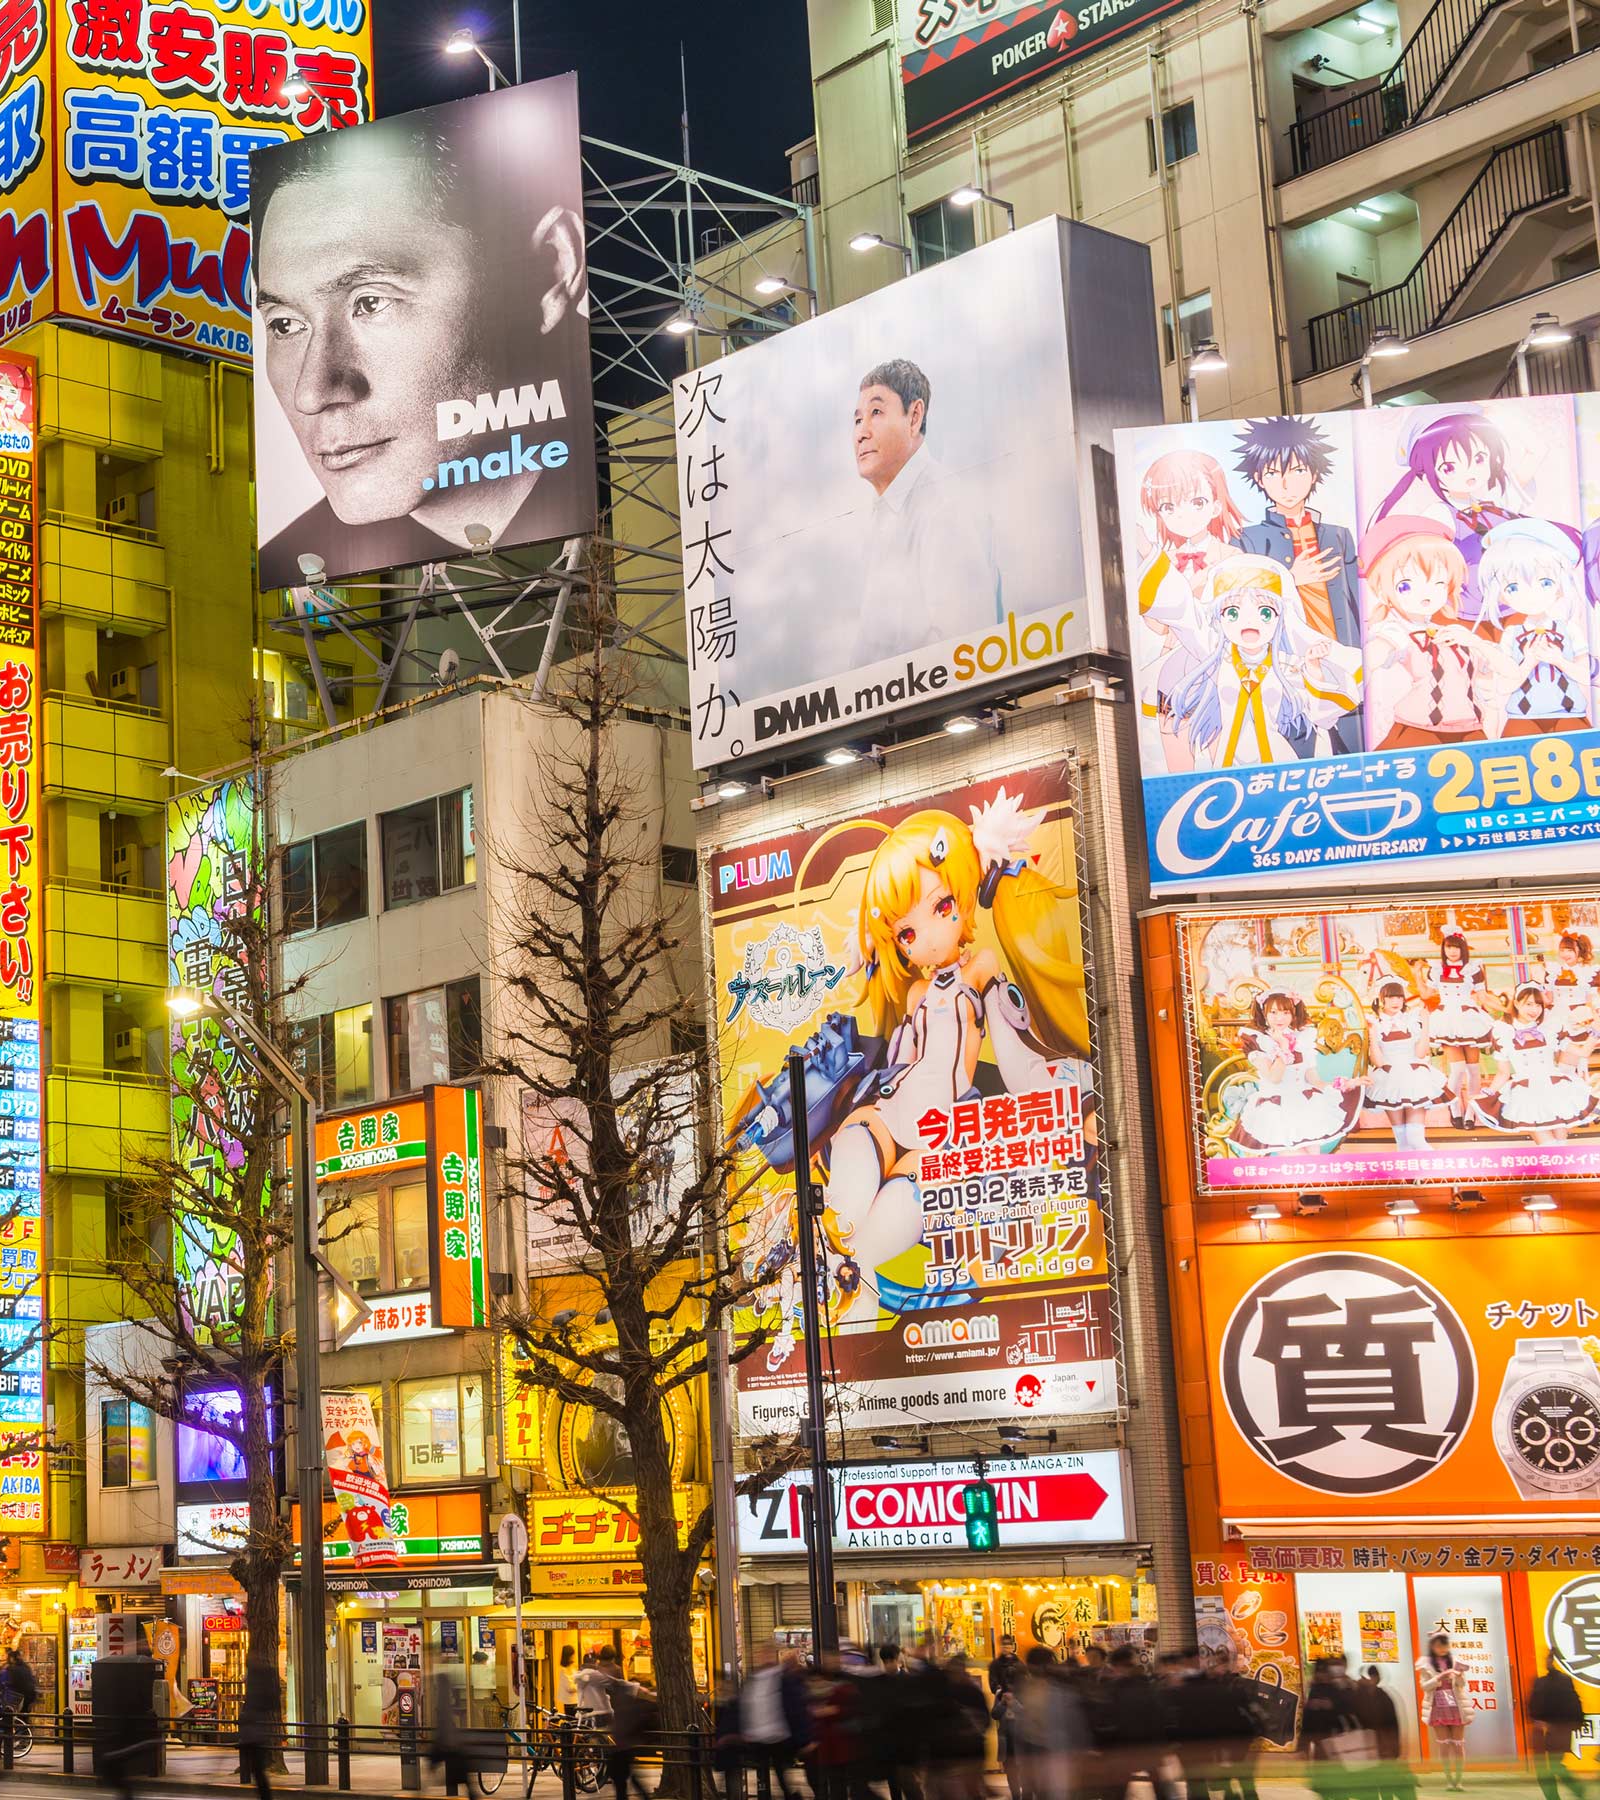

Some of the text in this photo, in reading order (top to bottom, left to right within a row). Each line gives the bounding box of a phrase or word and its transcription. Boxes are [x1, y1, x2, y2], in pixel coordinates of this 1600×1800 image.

[70, 0, 364, 128] 激安販売
[991, 31, 1048, 76] POKER
[100, 296, 197, 341] ムーラン
[436, 379, 568, 442] DMM
[421, 434, 570, 492] .make
[1, 520, 25, 540] CD
[677, 370, 745, 758] 次は太陽か。
[953, 609, 1076, 682] solar
[1248, 758, 1417, 796] あにばーさる
[1253, 837, 1429, 868] 365 DAYS ANNIVERSARY
[719, 849, 793, 895] PLUM
[13, 1021, 39, 1041] 中古
[14, 1069, 40, 1090] 中古
[0, 1098, 38, 1117] DVD
[917, 1084, 1082, 1152] 今月発売!!
[14, 1119, 40, 1140] 中古
[337, 1112, 401, 1154] 吉野家
[340, 1147, 398, 1171] YOSHINOYA
[921, 1131, 1085, 1182] 最終受注受付中!
[14, 1169, 40, 1190] 中古
[921, 1170, 1086, 1213] 2019.2 発売予定
[441, 1151, 468, 1261] 吉野家
[467, 1156, 483, 1260] YOSHINOYA
[922, 1196, 1089, 1231] 1/7 Scale Pre-Painted Figure
[923, 1213, 1091, 1272] エルドリッジ
[1, 1247, 38, 1270] 買取
[925, 1254, 1095, 1288] USS Eldridge
[15, 1298, 41, 1318] 中古
[1485, 1298, 1599, 1329] チケット
[903, 1313, 1000, 1349] amiami
[904, 1346, 1001, 1365] http://www.amiami.jp/
[0, 1374, 41, 1394] B1F 中古
[1253, 1286, 1454, 1463] 質
[752, 1404, 801, 1423] Figures,
[858, 1391, 897, 1412] Anime
[900, 1390, 941, 1412] goods
[943, 1388, 968, 1406] and
[971, 1387, 1008, 1404] more
[843, 1455, 1086, 1482] Professional Support for & MANGA-ZIN
[1, 1476, 41, 1495] AKIBA
[0, 1501, 41, 1520] 中央通り店
[849, 1482, 967, 1527] COMIC
[440, 1537, 481, 1552] YOSHINOYA
[847, 1527, 954, 1549] Akihabara
[90, 1553, 153, 1583] ラーメン
[1250, 1546, 1345, 1570] 高価買取
[326, 1580, 370, 1591] YOSHINOYA
[407, 1576, 452, 1589] YOSHINOYA
[205, 1617, 242, 1631] OPEN
[1434, 1617, 1489, 1634] 大黒屋
[409, 1633, 422, 1654] 牛
[1470, 1665, 1495, 1675] 19:30
[1467, 1680, 1496, 1693] 買取
[1471, 1698, 1498, 1711] 入口
